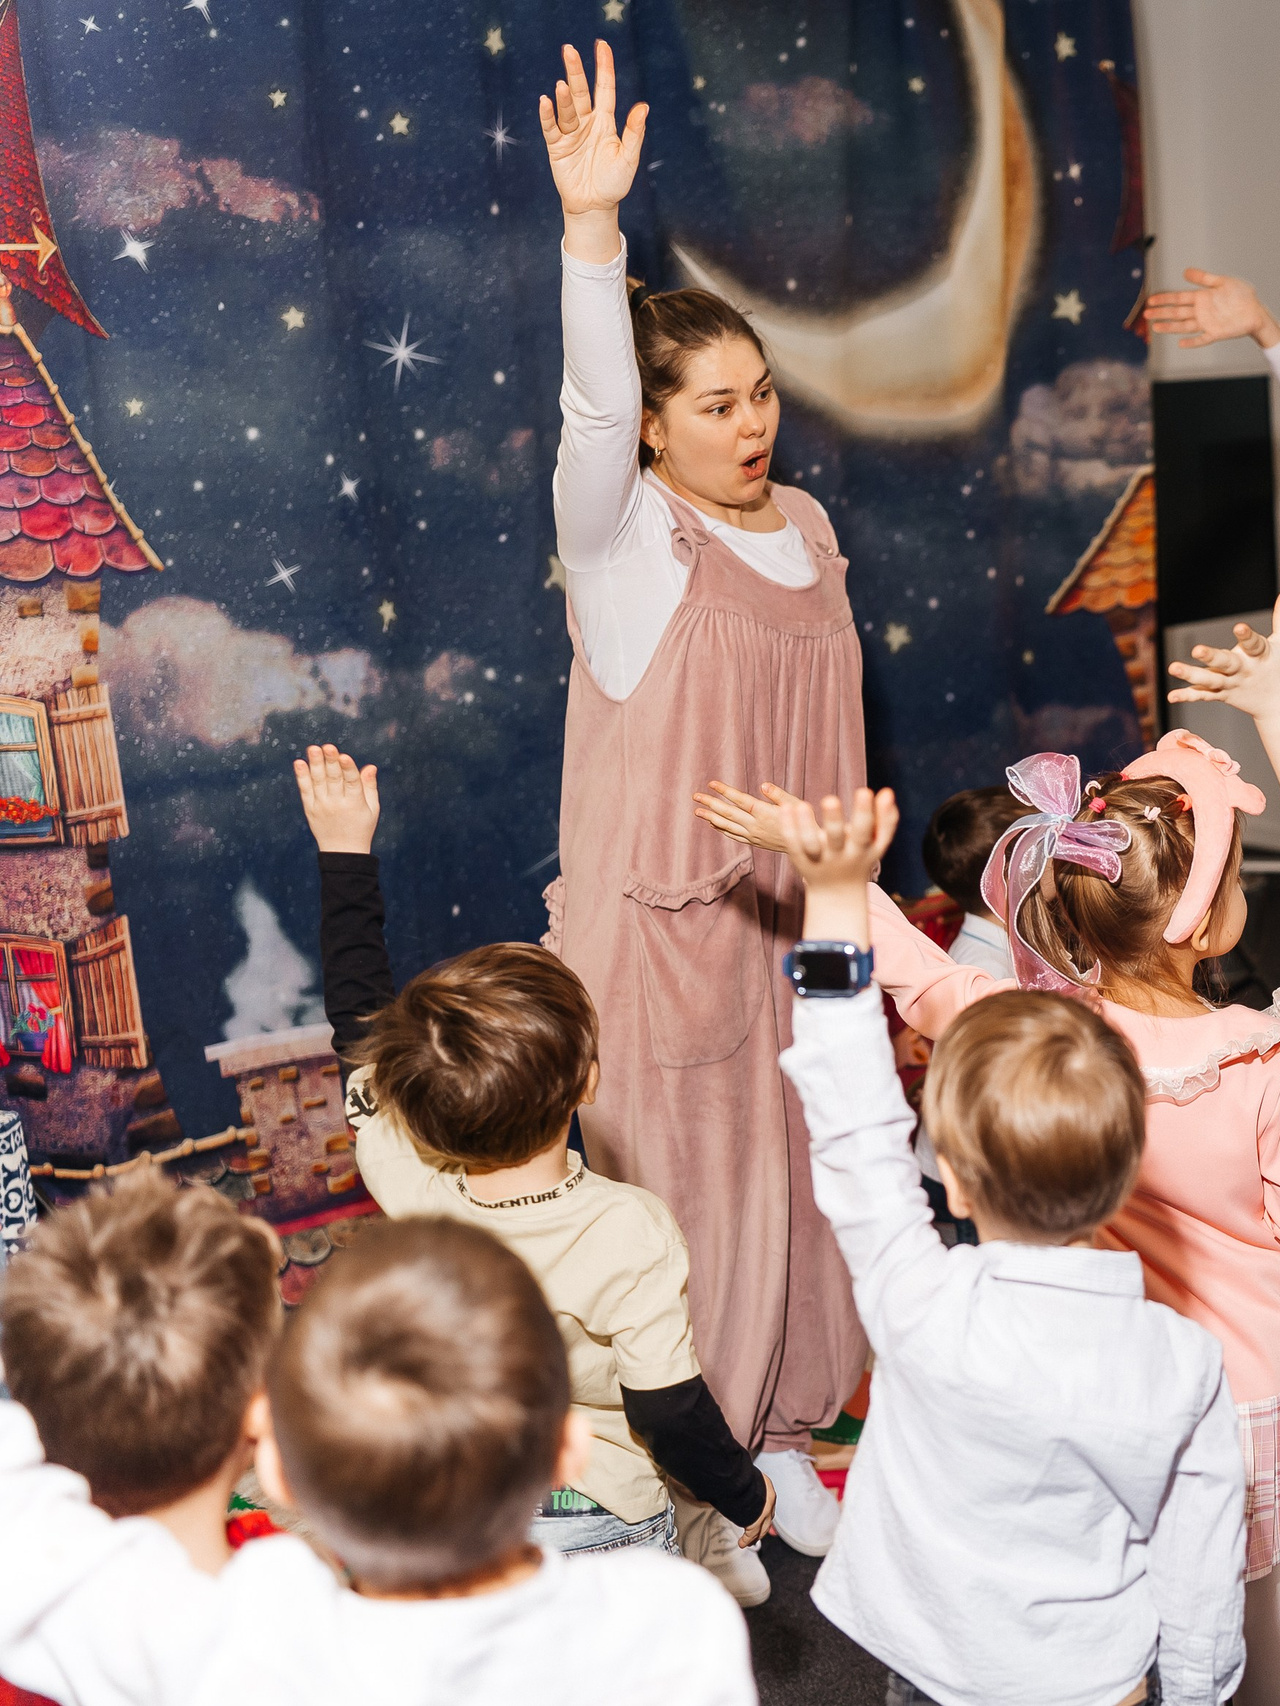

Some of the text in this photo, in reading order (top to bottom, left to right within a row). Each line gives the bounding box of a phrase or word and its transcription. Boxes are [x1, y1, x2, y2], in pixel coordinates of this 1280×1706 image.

[455, 1166, 585, 1209] THE ADVENTURE STR
